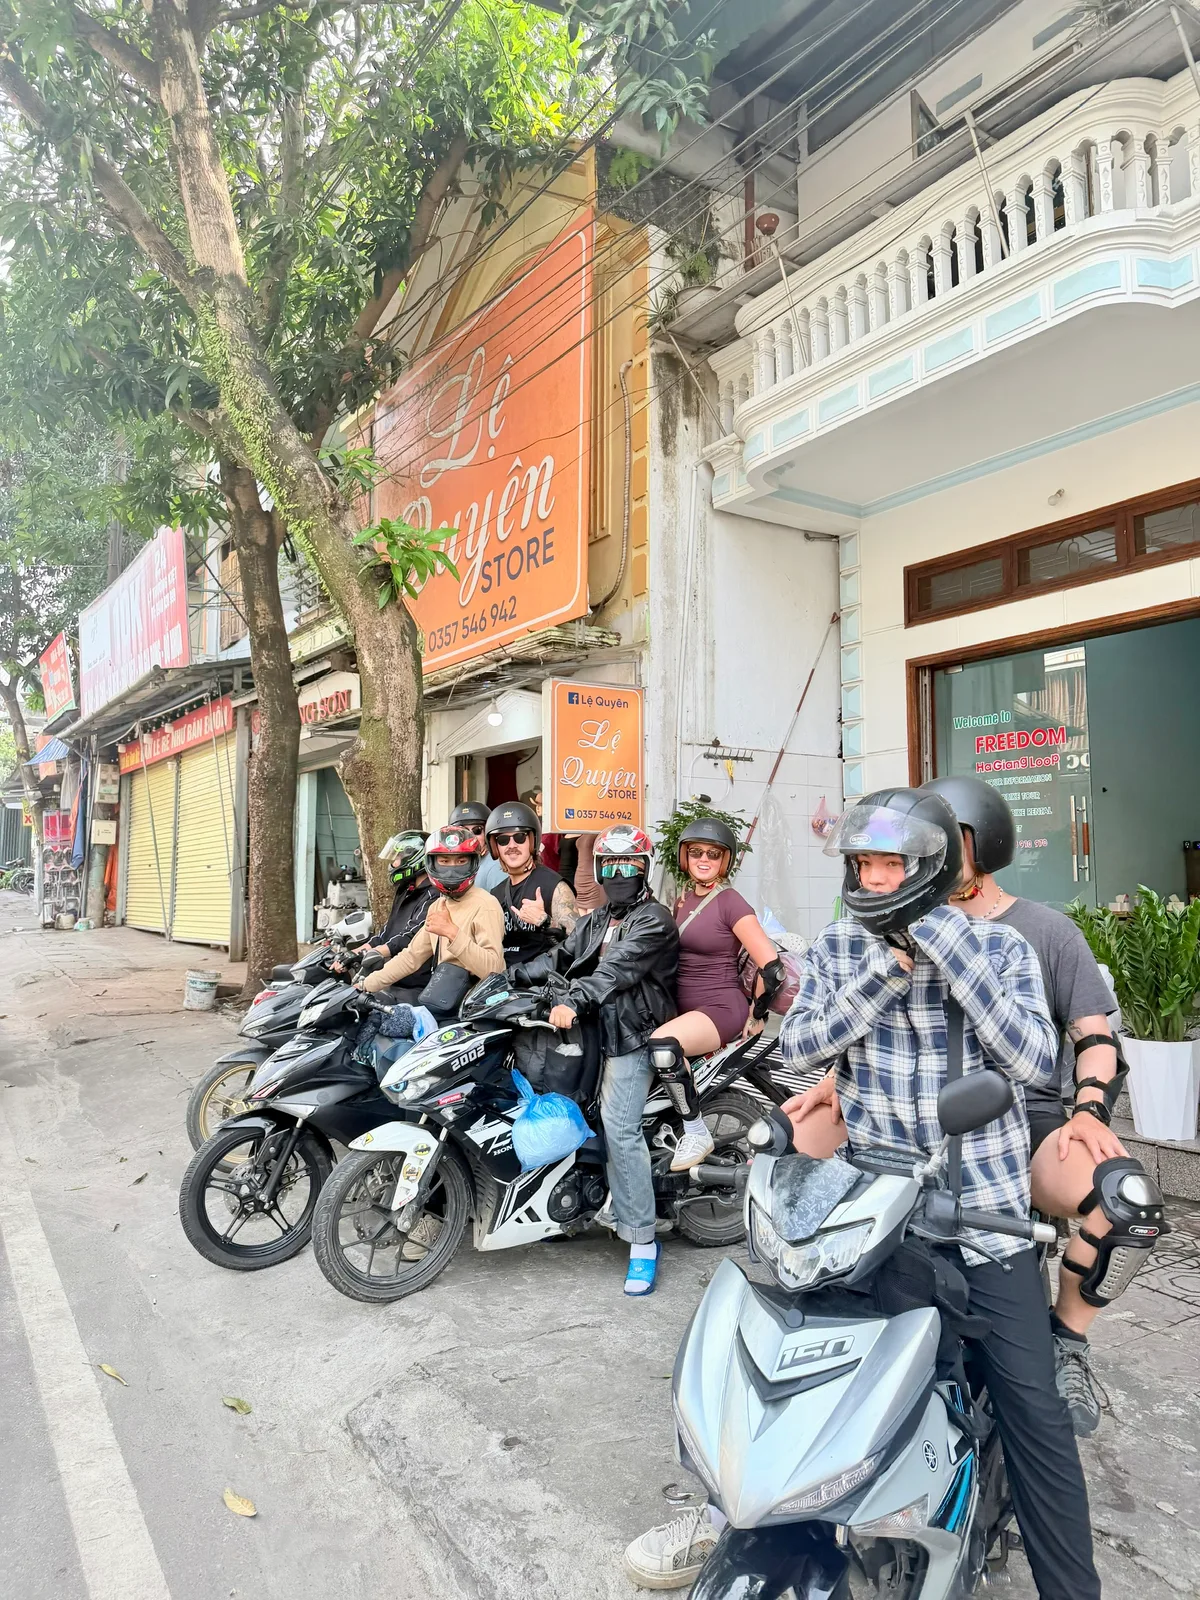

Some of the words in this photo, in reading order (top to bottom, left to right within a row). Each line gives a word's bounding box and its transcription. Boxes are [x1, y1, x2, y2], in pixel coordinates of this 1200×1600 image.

[420, 346, 514, 488] Lệ
[480, 527, 555, 593] STORE
[428, 617, 460, 653] 0357
[461, 609, 488, 641] 546
[490, 595, 518, 632] 942
[298, 701, 319, 726] NG
[581, 695, 593, 708] Lệ
[595, 696, 629, 709] Quyên
[953, 712, 998, 729] Welcome
[1000, 710, 1012, 723] to
[577, 720, 622, 754] Lệ
[975, 725, 1067, 754] FREEDOM
[560, 755, 637, 799] Quyên
[1003, 773, 1053, 785] INFORMATION
[607, 789, 637, 800] STORE
[1021, 791, 1041, 801] TOUR
[576, 809, 597, 819] 0357
[599, 810, 615, 820] 546
[616, 811, 632, 821] 942
[1026, 806, 1053, 816] RENTAL
[450, 1043, 486, 1072] 2002
[492, 1144, 513, 1157] HON
[777, 1335, 856, 1372] 150
